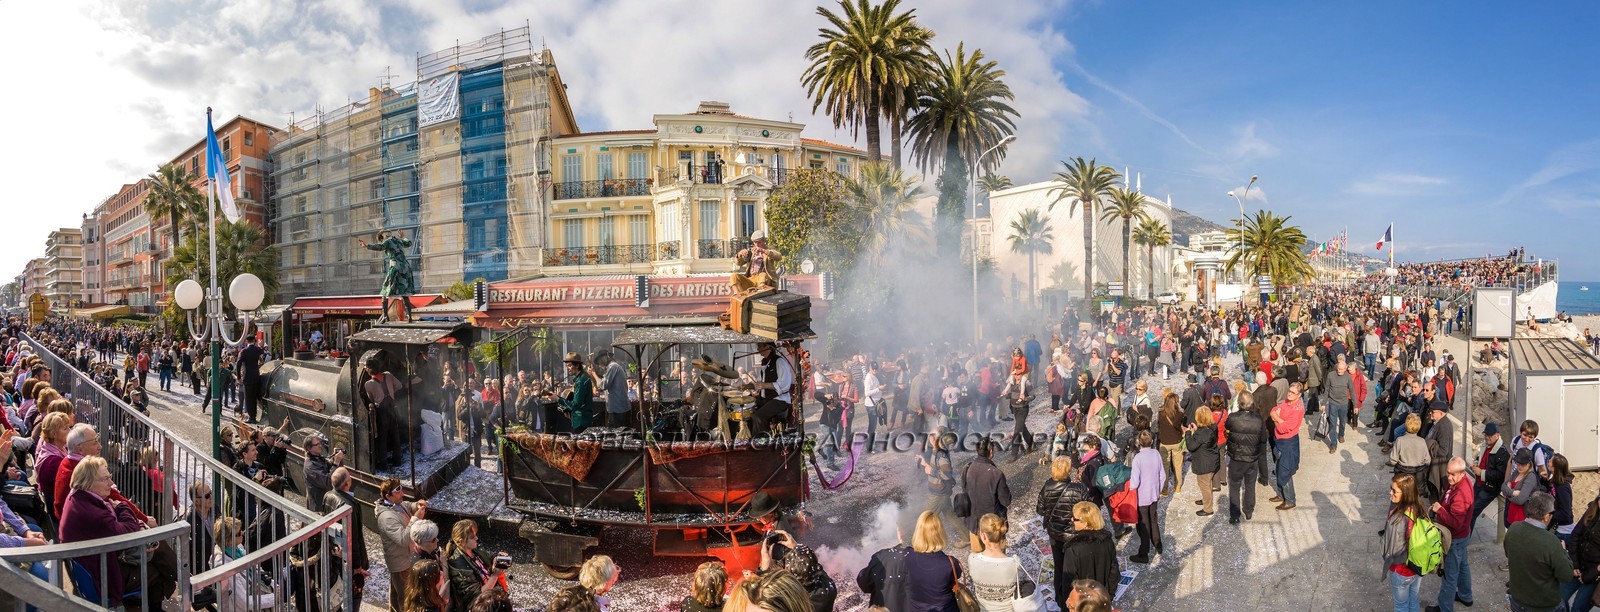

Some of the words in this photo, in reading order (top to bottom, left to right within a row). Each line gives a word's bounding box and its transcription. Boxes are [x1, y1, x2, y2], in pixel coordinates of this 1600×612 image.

[490, 287, 568, 303] RESTAURANT
[572, 285, 634, 300] PIZZERIA
[652, 284, 674, 298] DES
[678, 282, 732, 298] ARTISTES
